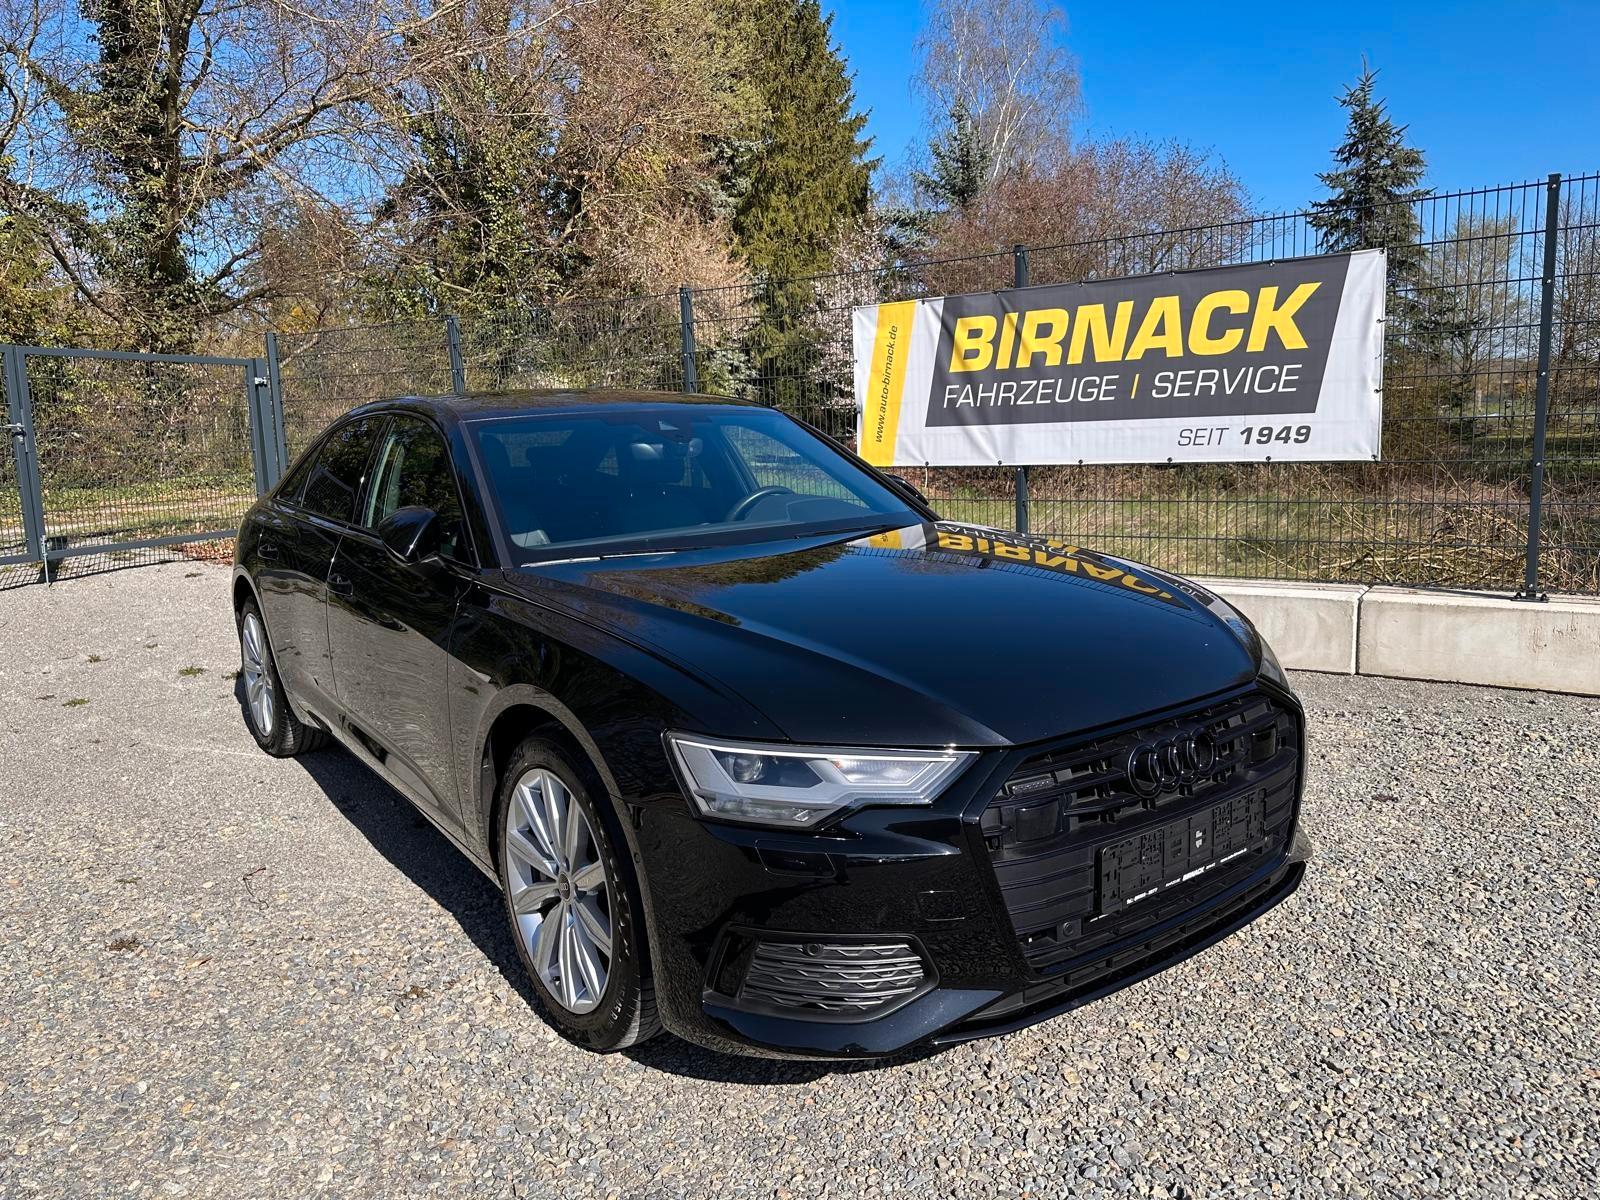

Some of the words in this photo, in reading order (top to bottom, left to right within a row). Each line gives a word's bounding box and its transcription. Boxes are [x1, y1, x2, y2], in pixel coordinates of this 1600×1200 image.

[949, 282, 1321, 373] BIRNACK
[875, 325, 898, 443] www.auto-birnack.de
[943, 374, 1120, 409] FAHRZEUGE
[1151, 364, 1303, 399] SERVICE
[1177, 427, 1230, 447] SEIT
[1239, 425, 1312, 445] 1949
